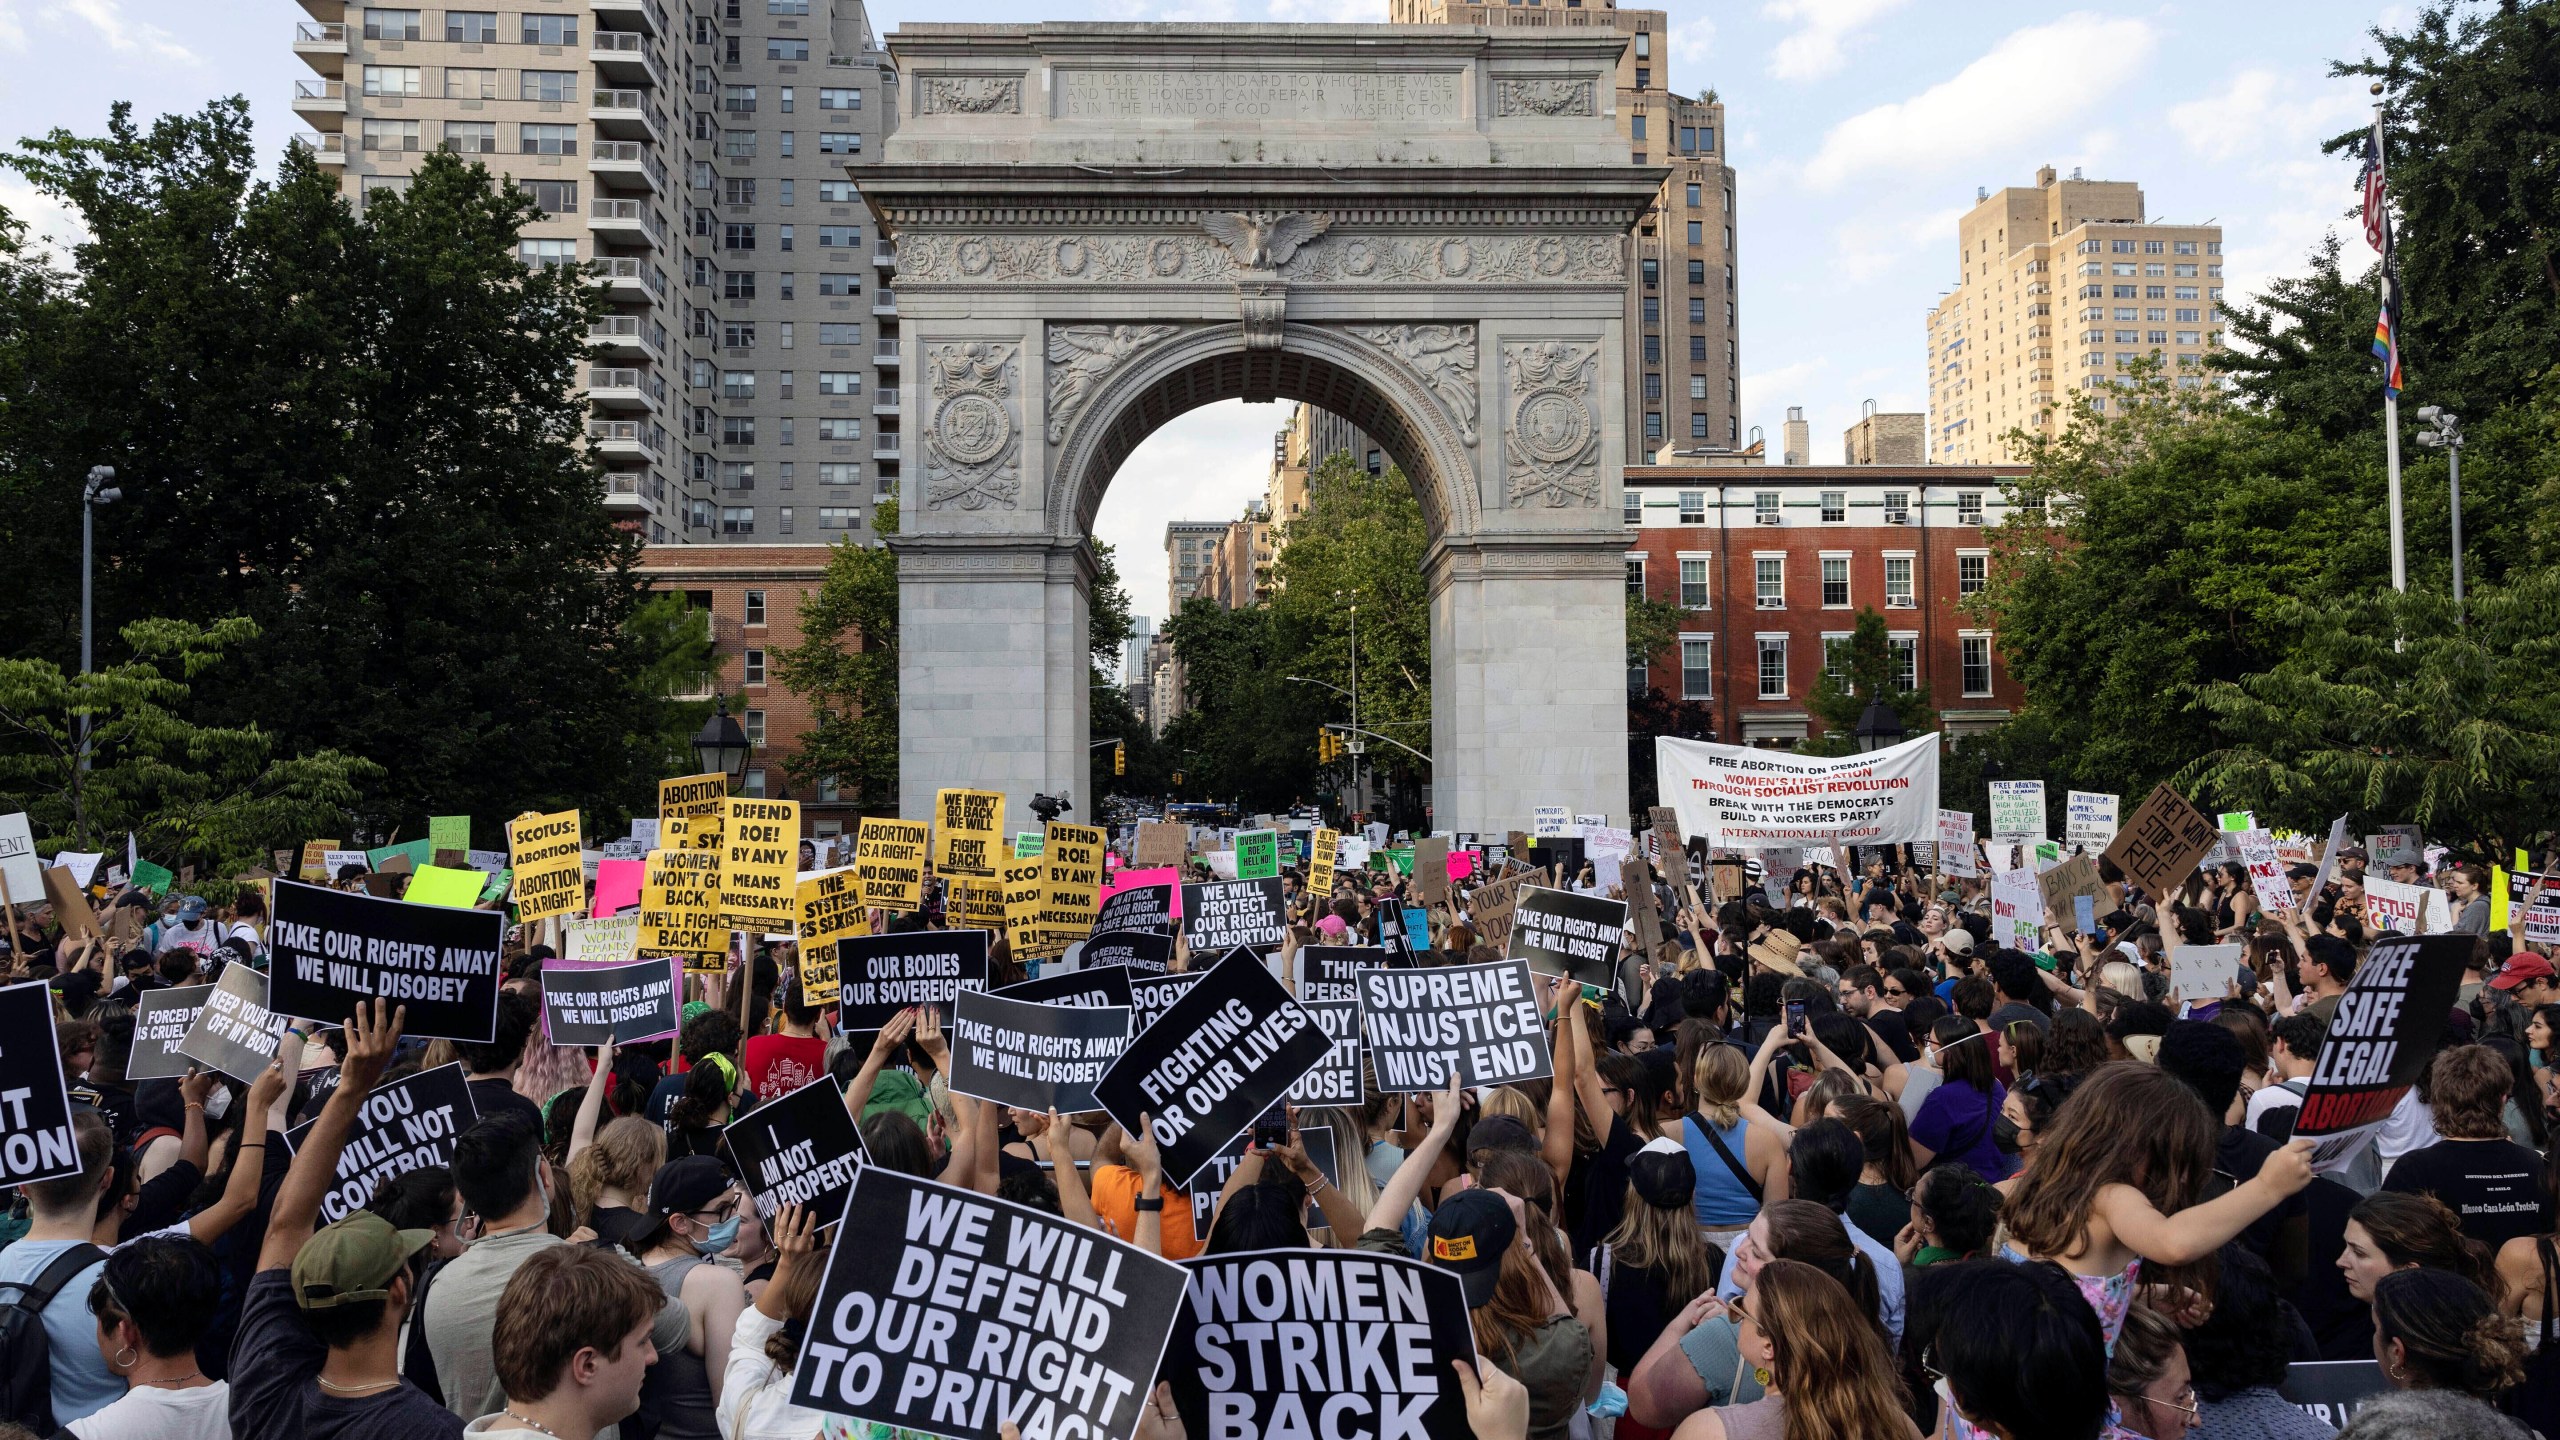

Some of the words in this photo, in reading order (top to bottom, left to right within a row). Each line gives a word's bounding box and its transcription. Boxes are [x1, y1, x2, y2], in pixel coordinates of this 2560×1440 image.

[1067, 74, 1096, 86] LET
[1103, 75, 1120, 86] US
[1125, 75, 1171, 86] RAISE
[1178, 75, 1189, 86] A
[1194, 75, 1281, 87] STANDARD
[1288, 75, 1310, 87] TO
[1315, 75, 1369, 87] WHICH
[1375, 76, 1407, 88] THE
[1414, 76, 1452, 88] WISE
[1067, 88, 1099, 100] AND
[1106, 88, 1140, 100] THE
[1149, 88, 1214, 100] HONEST
[1225, 89, 1260, 100] CAN
[1269, 89, 1325, 101] REPAIR
[1353, 90, 1386, 101] THE
[1396, 90, 1451, 101] EVENT
[1067, 102, 1080, 114] IS
[1087, 102, 1101, 114] IN
[1109, 102, 1142, 114] THE
[1151, 102, 1198, 114] HAND
[1206, 103, 1228, 115] OF
[1235, 103, 1270, 115] GOD
[1340, 103, 1453, 116] WASHINGTON
[1709, 756, 1737, 769] FREE
[1741, 760, 1804, 774] ABORTION
[1808, 767, 1826, 775] ON
[1692, 779, 1752, 797] THROUGH
[1754, 783, 1825, 798] SOCIALIST
[1827, 777, 1909, 792] REVOLUTION
[1724, 773, 1788, 786] WOMEN'S
[1709, 797, 1748, 811] BREAK
[1751, 803, 1784, 813] WITH
[1788, 802, 1813, 811] THE
[1817, 797, 1894, 810] DEMOCRATS
[2073, 794, 2108, 805] CAPITALISM
[2151, 785, 2189, 825] THEY
[733, 803, 791, 821] DEFEND
[1721, 811, 1756, 823] BUILD
[1761, 814, 1770, 823] A
[1773, 813, 1836, 823] WORKERS
[1840, 810, 1881, 821] PARTY
[2074, 813, 2112, 822] OPPRESSION
[516, 820, 575, 845] SCOTUS:
[739, 825, 780, 843] ROE!
[860, 823, 925, 844] ABORTION
[1240, 833, 1272, 846] OVERTURN
[1721, 827, 1840, 839] INTERNATIONALIST
[1841, 827, 1881, 837] GROUP
[2067, 831, 2111, 840] REVOLUTIONARY
[2137, 815, 2176, 849] STOP
[2162, 841, 2192, 866] AT
[516, 842, 580, 866] ABORTION
[731, 846, 750, 862] BY
[751, 848, 788, 864] ANY
[858, 842, 871, 857] IS
[870, 843, 879, 858] A
[1243, 856, 1260, 867] HELL
[1260, 854, 1271, 865] NO!
[859, 864, 877, 880] NO
[878, 866, 919, 883] GOING
[2121, 839, 2172, 889] ROE
[519, 867, 581, 898] ABORTION
[733, 873, 781, 890] MEANS
[865, 881, 906, 898] BACK!
[1201, 885, 1225, 901] WE
[1228, 881, 1264, 899] WILL
[2511, 874, 2529, 885] STOP
[2513, 883, 2523, 893] ON
[520, 899, 532, 917] IS
[533, 897, 541, 914] A
[720, 892, 794, 911] NECESSARY!
[1200, 896, 1268, 917] PROTECT
[2366, 893, 2417, 920] FETUS
[1194, 916, 1227, 933] OUR
[1230, 911, 1276, 930] RIGHT
[1517, 908, 1542, 929] TAKE
[1542, 913, 1563, 932] OUR
[1563, 917, 1597, 940] RIGHTS
[1596, 924, 1622, 945] AWAY
[2370, 911, 2399, 930] GAY
[2511, 909, 2560, 925] SCIALIST
[275, 919, 320, 953] TAKE
[324, 929, 362, 962] OUR
[366, 937, 436, 971] RIGHTS
[440, 946, 496, 976] AWAY
[1185, 933, 1206, 949] TO
[1210, 925, 1287, 947] ABORTION
[1524, 929, 1541, 948] WE
[1542, 932, 1566, 953] WILL
[1568, 937, 1609, 962] DISOBEY
[867, 956, 901, 980] OUR
[904, 953, 960, 978] BODIES
[2350, 943, 2422, 988] FREE
[295, 954, 324, 984] WE
[328, 961, 373, 995] WILL
[378, 970, 469, 1003] DISOBEY
[1368, 966, 1524, 1009] SUPREME
[842, 982, 877, 1006] OUR
[208, 988, 241, 1015] KEEP
[238, 999, 270, 1029] YOUR
[2331, 991, 2406, 1037] SAFE
[207, 1012, 233, 1036] OFF
[227, 1021, 252, 1044] MY
[244, 1029, 279, 1058] BODY
[1367, 1001, 1541, 1047] INJUSTICE
[1139, 998, 1253, 1106] FIGHTING
[1384, 1049, 1460, 1086] MUST
[1469, 1040, 1537, 1081] END
[2312, 1041, 2399, 1086] LEGAL
[1140, 1104, 1196, 1147] OR
[1185, 1059, 1246, 1116] OUR
[1232, 1001, 1307, 1073] LIVES
[357, 1085, 414, 1131] YOU
[336, 1128, 403, 1180] WILL
[401, 1104, 455, 1146] NOT
[768, 1124, 780, 1150] I
[760, 1155, 783, 1188] AM
[778, 1138, 817, 1178] NOT
[324, 1143, 450, 1220] CONTROL
[753, 1189, 779, 1220] YOUR
[776, 1147, 864, 1209] PROPERTY
[2461, 1203, 2483, 1214] Museo
[2483, 1203, 2499, 1213] Casa
[2498, 1202, 2515, 1213] León
[2515, 1200, 2540, 1213] Trotsky
[905, 1189, 995, 1258] WE
[1006, 1216, 1128, 1308] WILL
[892, 1244, 1111, 1353] DEFEND
[1187, 1259, 1430, 1323] WOMEN
[832, 1291, 957, 1364] OUR
[967, 1320, 1134, 1427] RIGHT
[1194, 1322, 1440, 1394] STRIKE
[808, 1341, 884, 1406] TO
[894, 1361, 1110, 1440] PRIVAC
[1208, 1392, 1440, 1440] BACK
